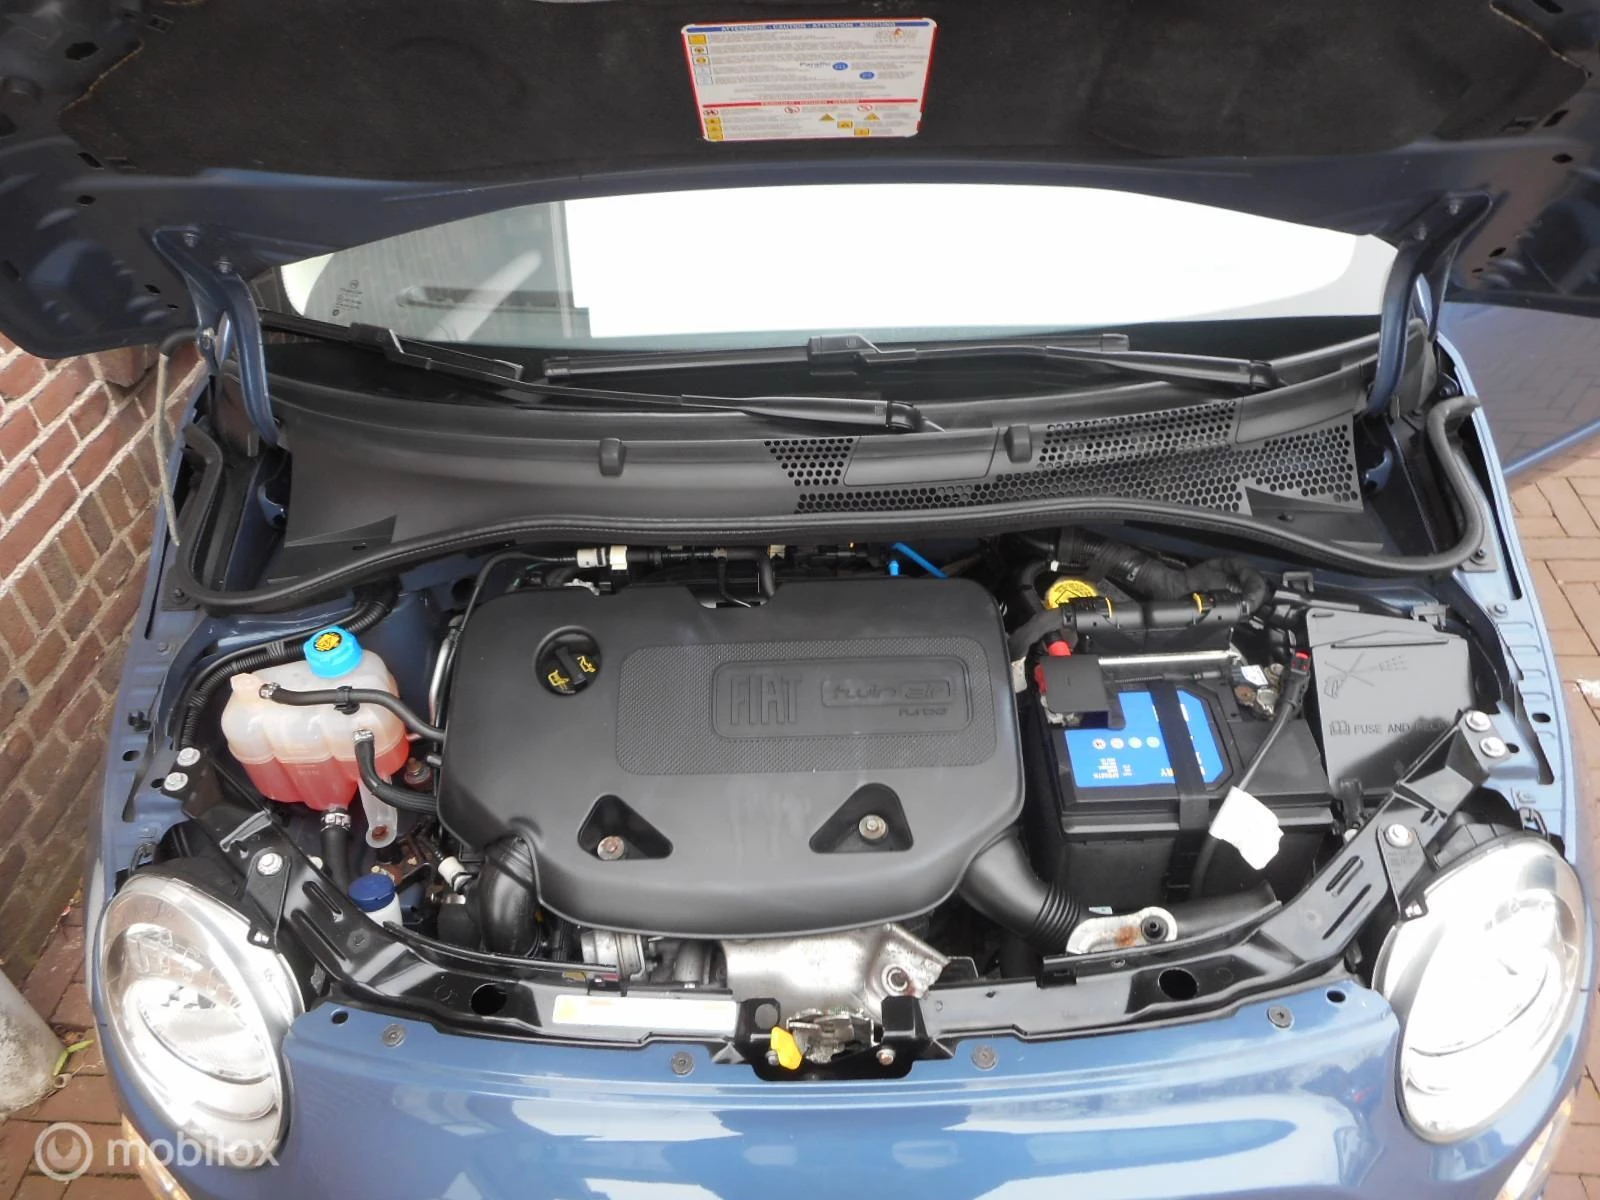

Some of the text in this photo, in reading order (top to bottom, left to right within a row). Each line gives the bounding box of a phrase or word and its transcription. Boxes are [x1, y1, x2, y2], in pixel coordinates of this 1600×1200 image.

[729, 675, 802, 726] FIAT
[1354, 724, 1382, 735] FUSE
[1388, 723, 1410, 733] AND
